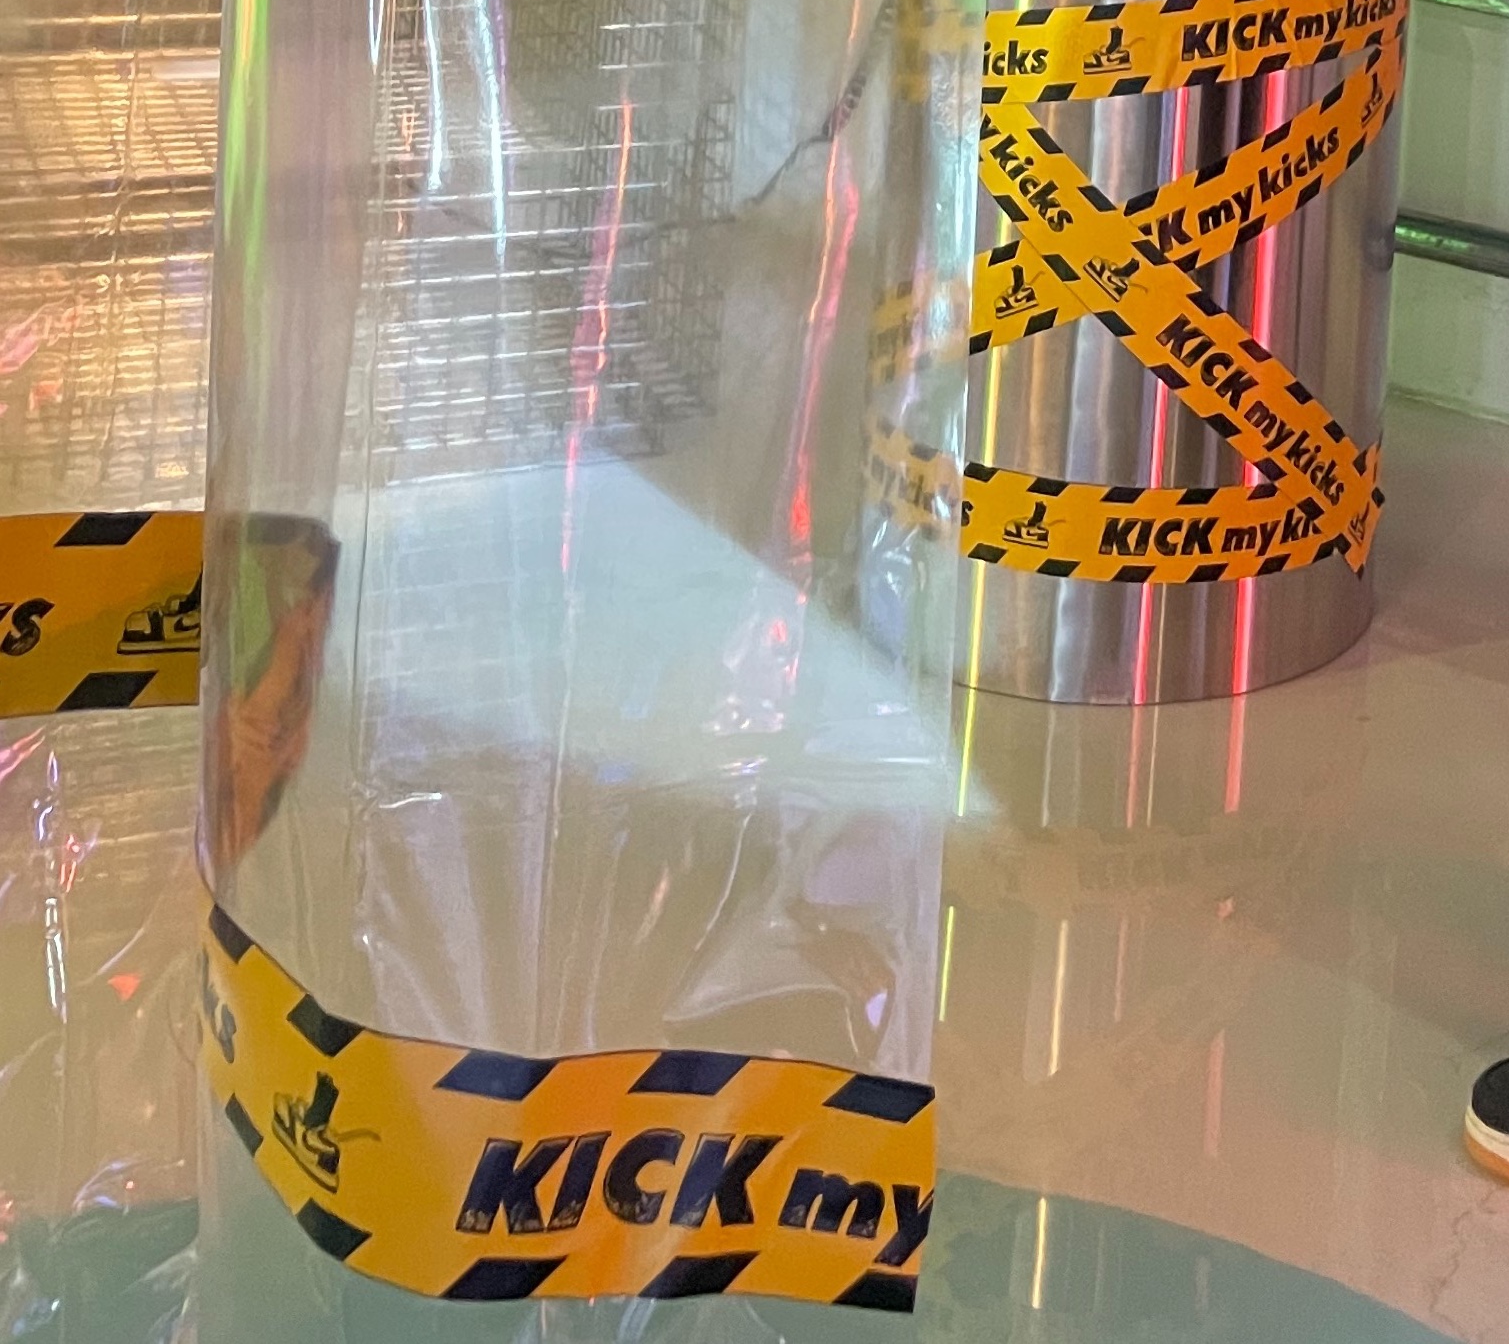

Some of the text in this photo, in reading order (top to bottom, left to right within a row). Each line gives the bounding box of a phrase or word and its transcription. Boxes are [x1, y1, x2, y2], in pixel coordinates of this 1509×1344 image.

[1182, 7, 1290, 61] KICK
[1294, 7, 1344, 42] my
[989, 133, 1074, 232] kicks
[1197, 183, 1255, 236] my
[1258, 126, 1340, 204] kicks
[1155, 313, 1345, 507] KICK my kicks
[1098, 516, 1221, 557] KICK
[1220, 519, 1282, 557] my
[456, 1127, 935, 1267] KICK my
